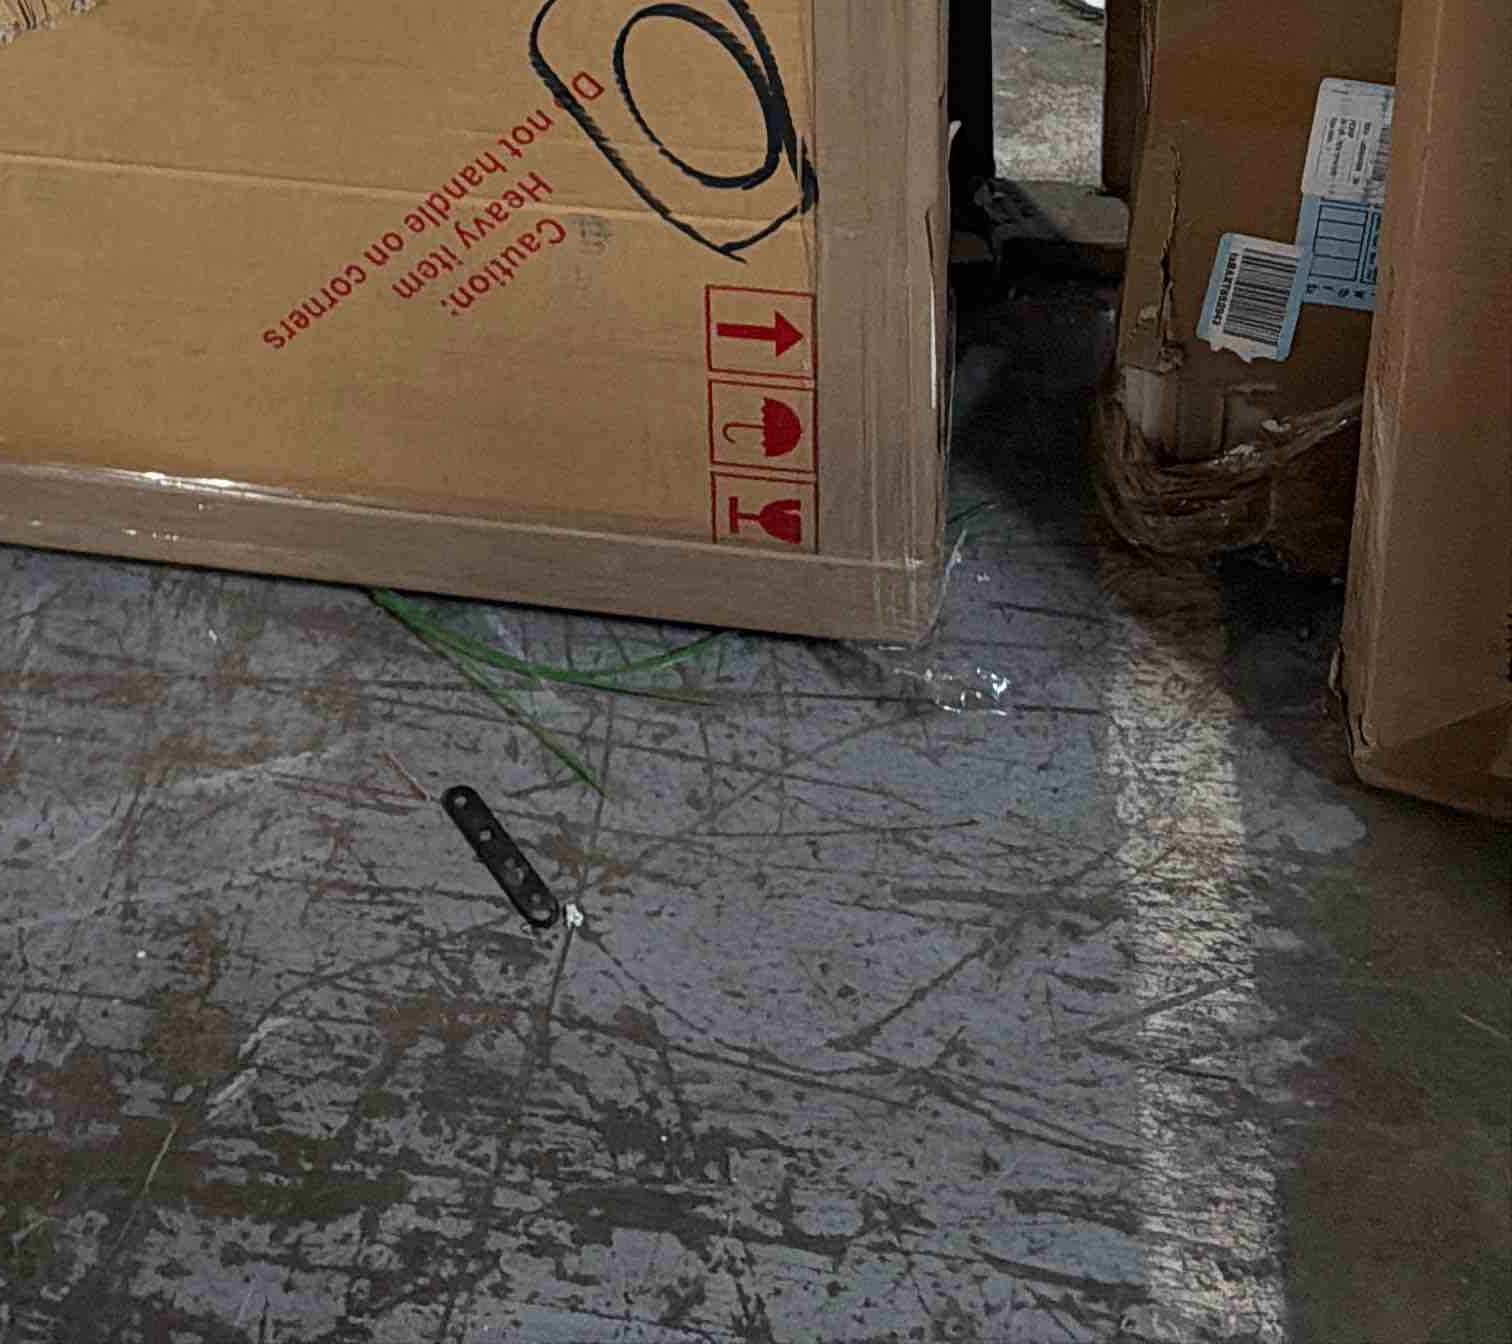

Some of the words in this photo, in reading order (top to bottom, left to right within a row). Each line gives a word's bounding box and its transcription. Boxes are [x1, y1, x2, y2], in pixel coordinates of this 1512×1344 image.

[499, 110, 554, 160] not
[403, 150, 507, 237] handle
[455, 171, 554, 252] Heavy
[362, 229, 407, 269] on
[390, 250, 465, 302] item
[440, 217, 568, 317] Caution:
[262, 263, 368, 351] corners
